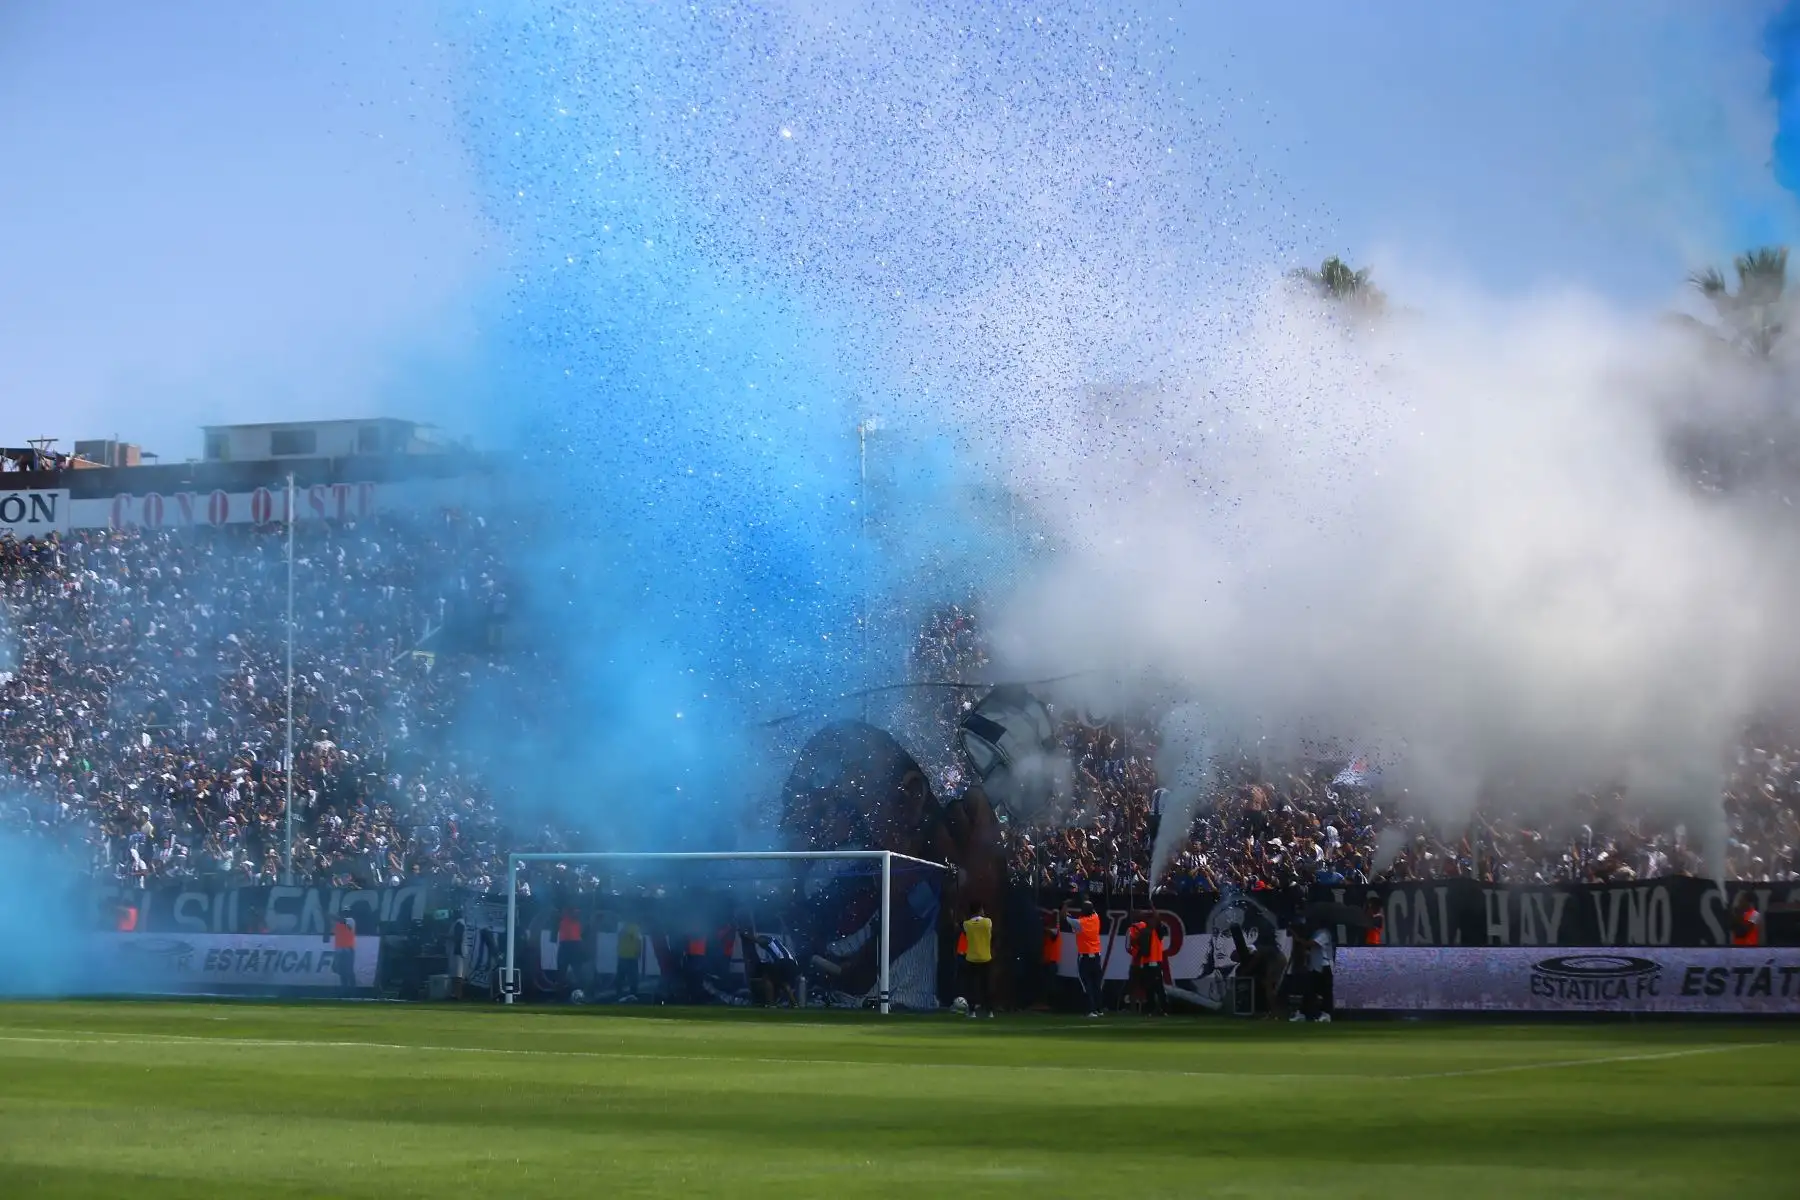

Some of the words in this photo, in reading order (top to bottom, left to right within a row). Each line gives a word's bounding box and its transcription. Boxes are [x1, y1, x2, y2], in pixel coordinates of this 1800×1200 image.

[1331, 886, 1462, 944] LCAL
[1482, 888, 1572, 944] HAY
[202, 944, 311, 973] ESTÁTICA
[1635, 974, 1661, 999] FC
